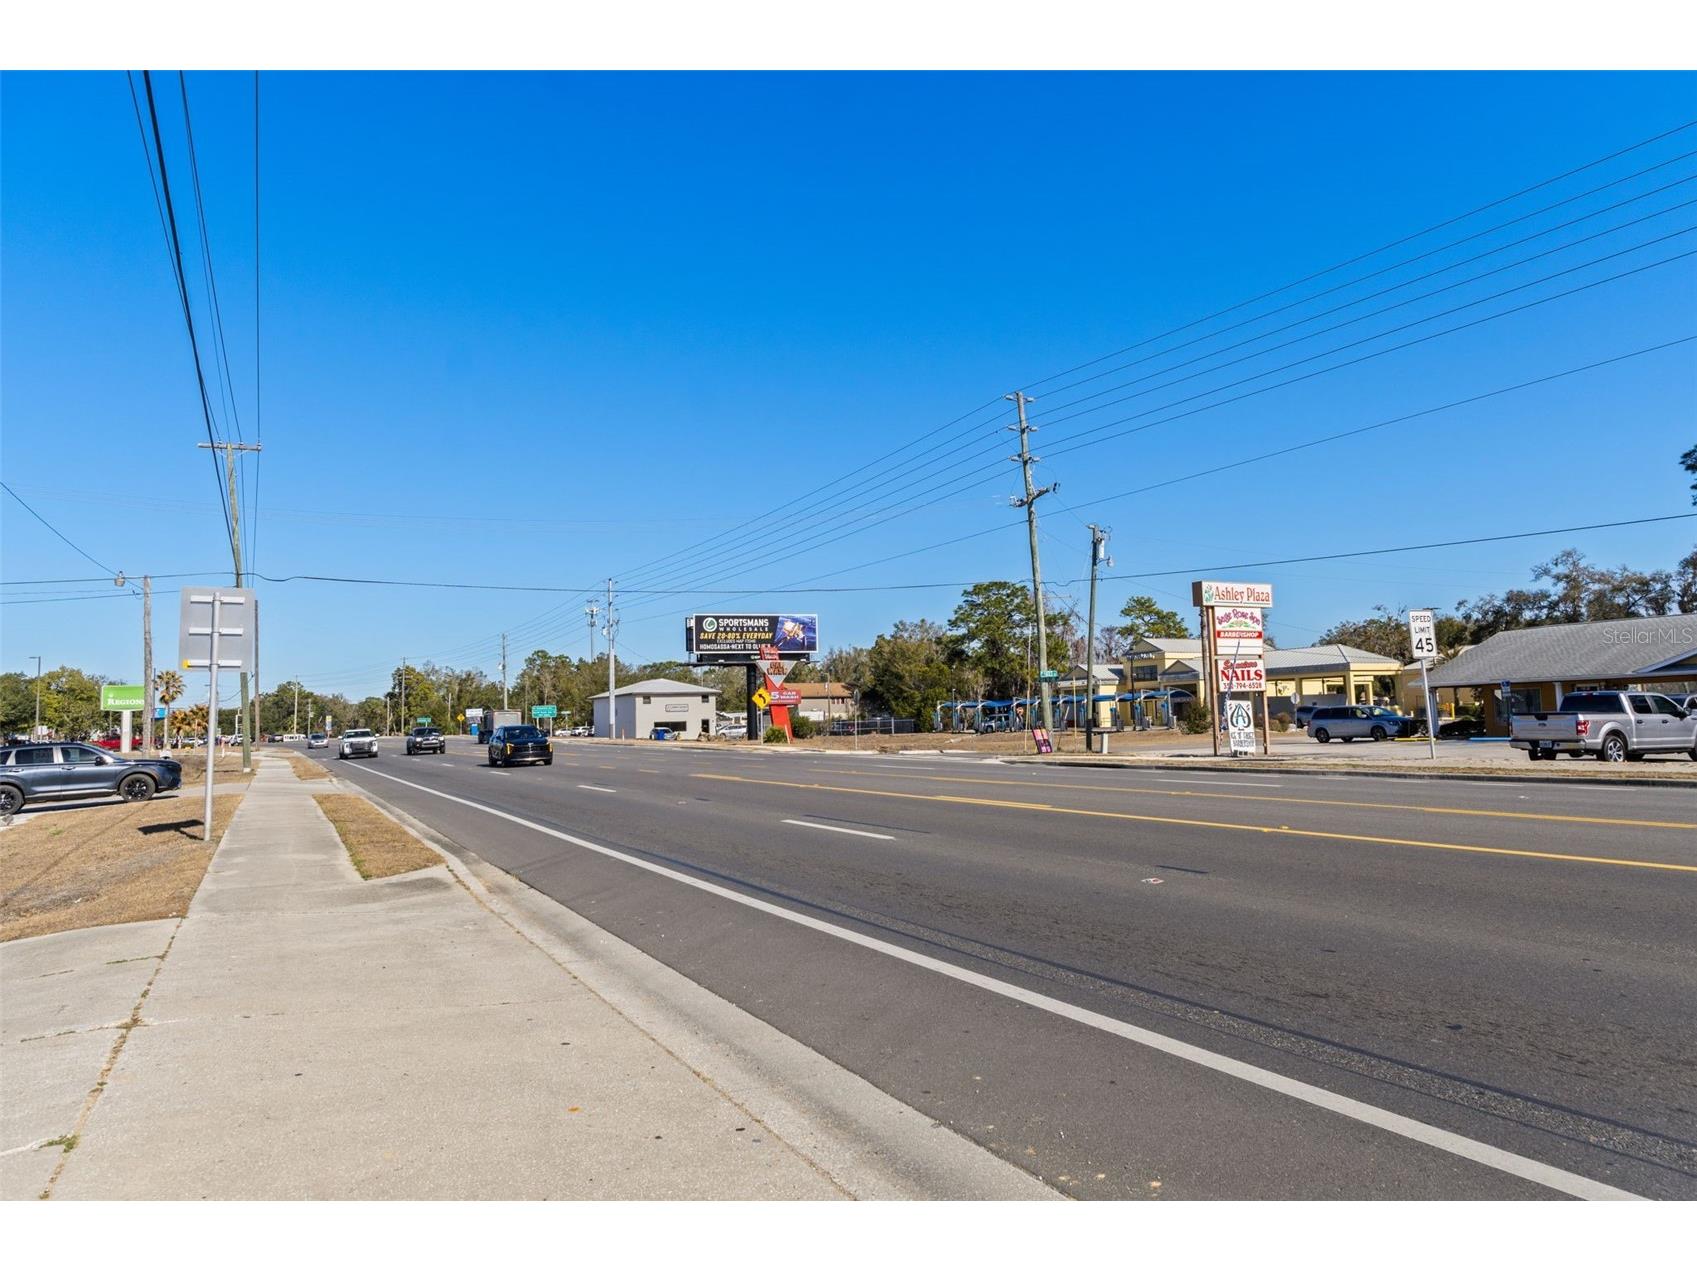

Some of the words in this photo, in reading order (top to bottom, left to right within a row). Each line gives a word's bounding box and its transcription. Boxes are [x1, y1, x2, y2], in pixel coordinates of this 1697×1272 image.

[1214, 586, 1244, 603] Ashley
[1247, 587, 1270, 602] Plaza
[1232, 608, 1249, 620] Rose
[1411, 615, 1431, 623] SPEED
[718, 618, 769, 627] SPORTSMANS
[1415, 638, 1434, 653] 45
[1220, 669, 1263, 681] NAILS
